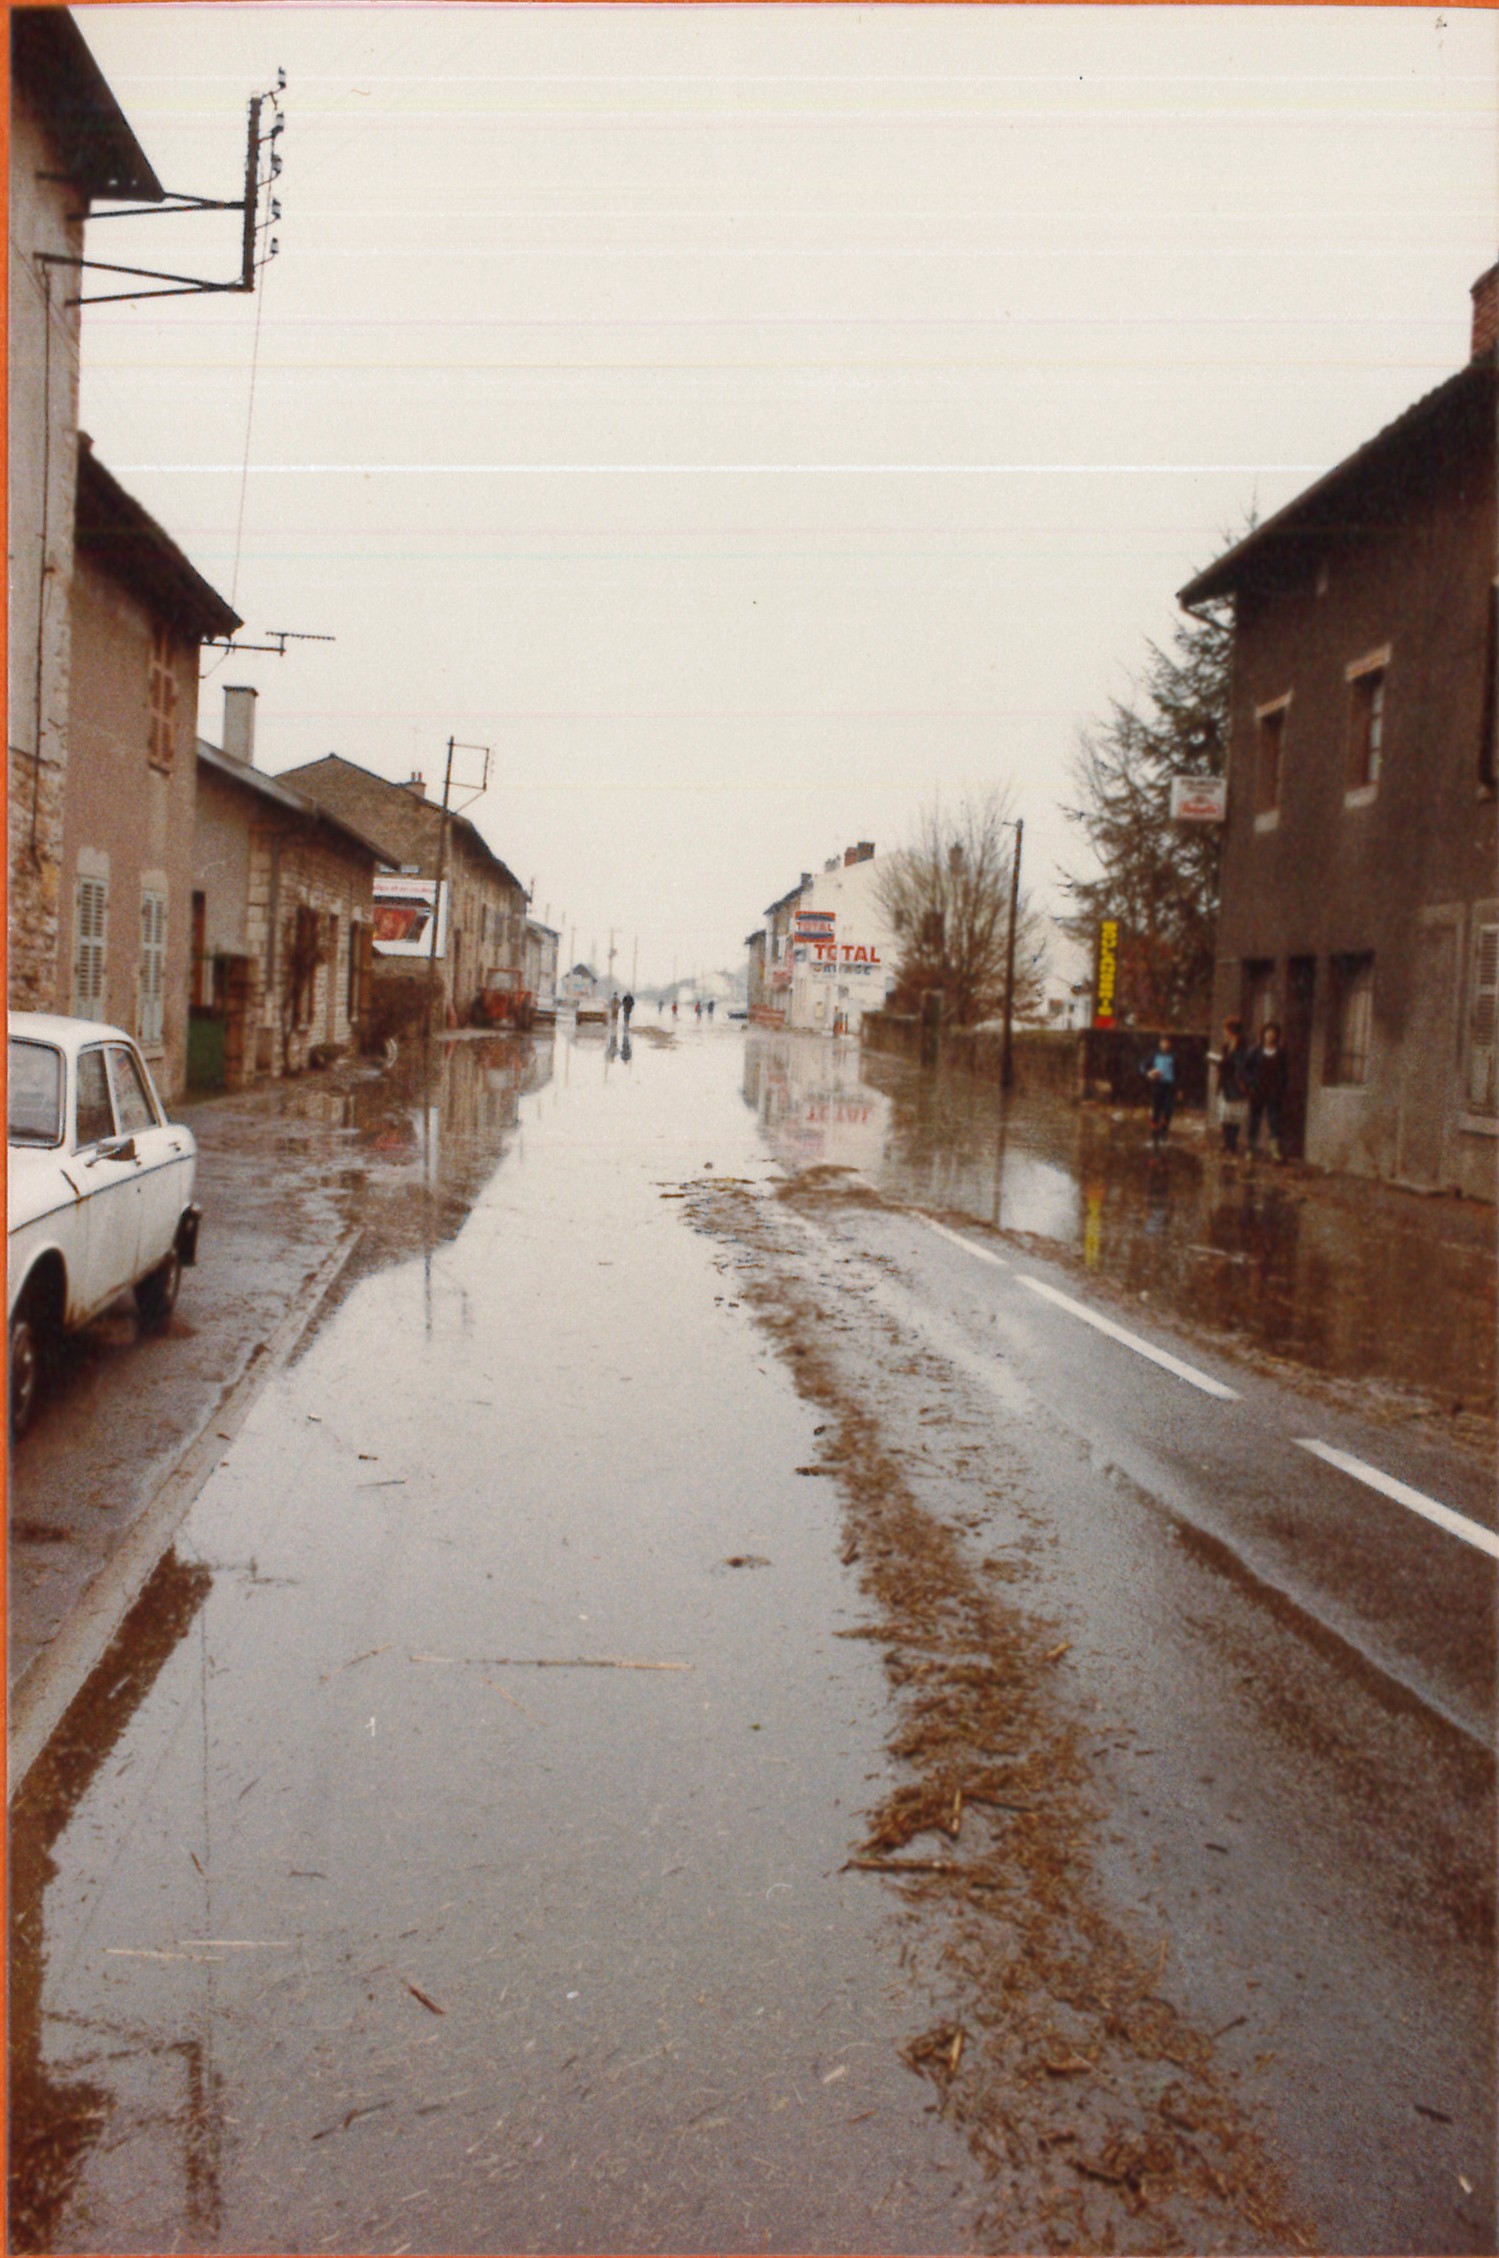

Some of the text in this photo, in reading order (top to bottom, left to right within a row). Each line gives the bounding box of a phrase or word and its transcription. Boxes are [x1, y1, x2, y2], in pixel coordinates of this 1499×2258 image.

[796, 920, 834, 932] TOTAL
[814, 944, 881, 963] TOTAL
[1098, 921, 1118, 1016] BOULANGERIE
